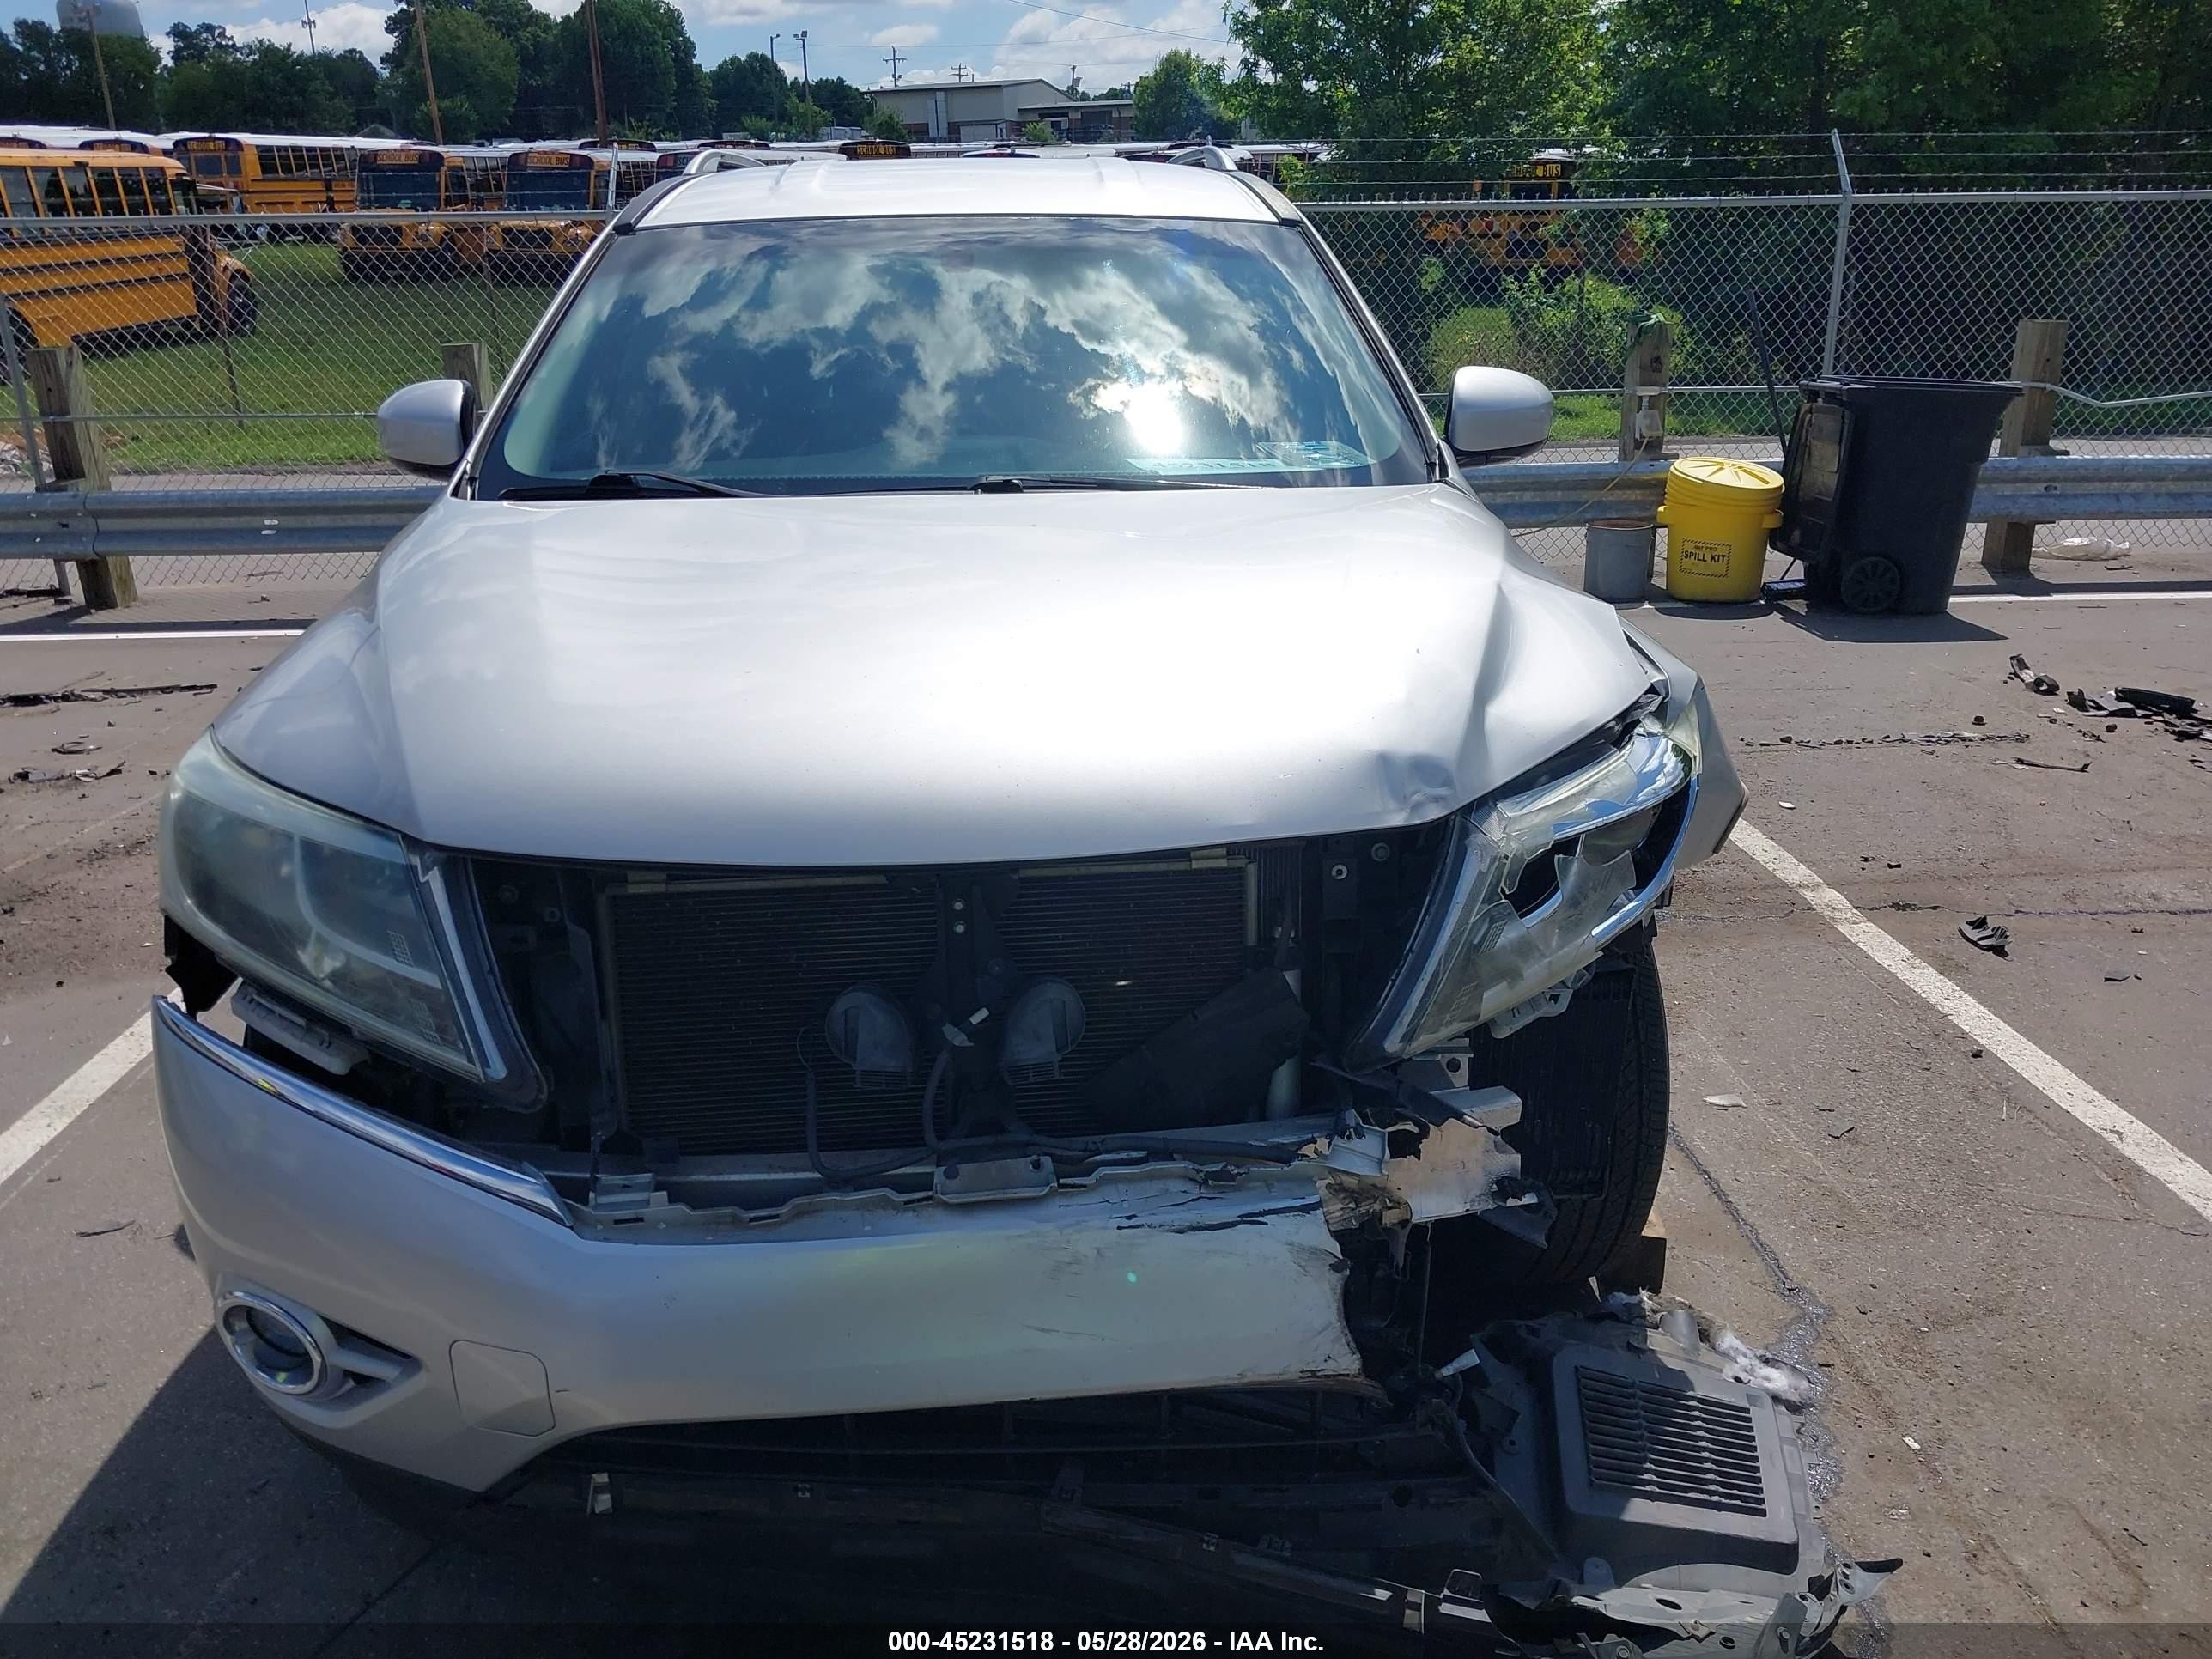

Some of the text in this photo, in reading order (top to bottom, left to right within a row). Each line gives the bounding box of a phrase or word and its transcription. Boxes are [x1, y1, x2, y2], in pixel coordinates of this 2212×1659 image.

[527, 155, 570, 166] SCHOOL BUS
[1542, 164, 1560, 178] BUS
[1684, 550, 1727, 564] SPILL KIT
